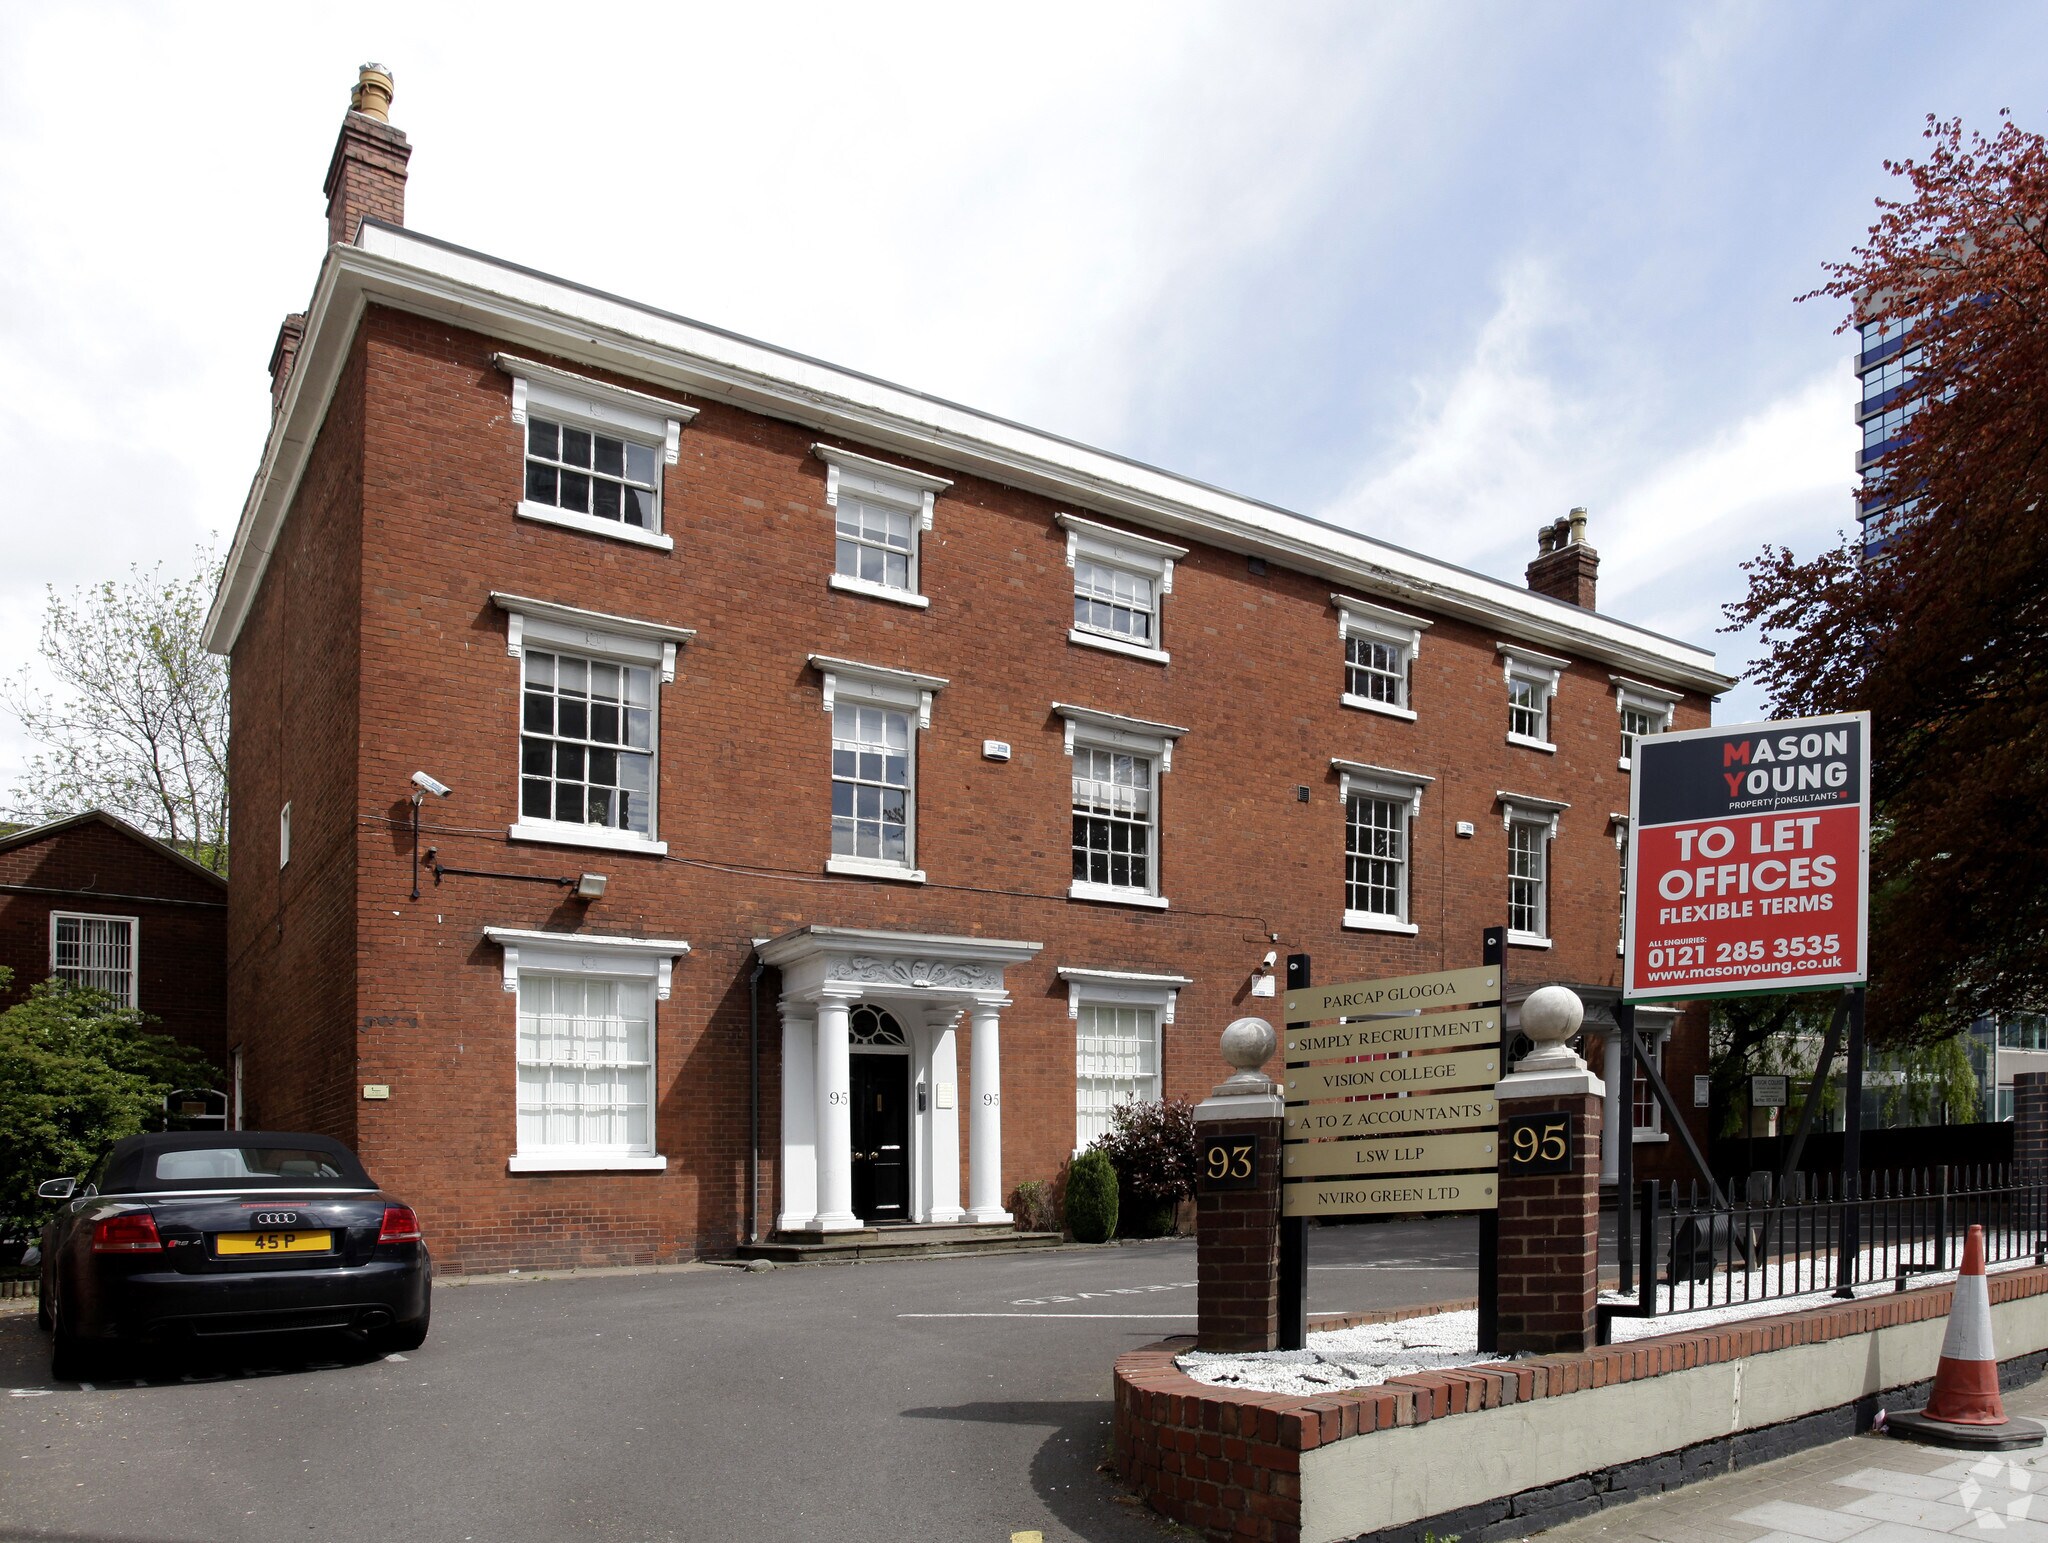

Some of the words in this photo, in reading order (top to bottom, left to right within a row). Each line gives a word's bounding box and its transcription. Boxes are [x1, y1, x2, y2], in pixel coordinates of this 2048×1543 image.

[1723, 730, 1848, 768] MASON
[1723, 761, 1848, 798] YOUNG
[1729, 797, 1773, 810] PROPERTY
[1774, 791, 1838, 805] CONSULTANTS
[1675, 826, 1735, 862] TO
[1750, 816, 1821, 855] LET
[1658, 855, 1837, 901] OFFICES
[1660, 900, 1753, 925] FLEXIBLE
[1759, 893, 1833, 917] TERMS
[1648, 940, 1663, 948] ALL
[1664, 936, 1707, 947] ENQUIRIES:
[1648, 945, 1705, 968] 0121
[1716, 940, 1765, 963] 285
[1773, 934, 1841, 958] 3535
[1648, 955, 1842, 982] www.masonyoung.co.uk
[1323, 991, 1384, 1009] PARCAP
[1388, 982, 1456, 1001] GLOGOA
[1299, 1034, 1353, 1051] SIMPLY
[1359, 1020, 1484, 1045] RECRUITMENT
[1323, 1071, 1375, 1088] VISION
[1380, 1064, 1457, 1083] COLLEGE
[829, 1091, 849, 1106] 95
[983, 1093, 1000, 1107] 95
[1300, 1118, 1311, 1130] A
[1316, 1115, 1337, 1128] TO
[1342, 1114, 1353, 1127] Z
[1357, 1104, 1482, 1126] ACCOUNTANTS
[1356, 1149, 1390, 1164] LSW
[1395, 1147, 1425, 1161] LLP
[1512, 1121, 1567, 1164] 95
[1206, 1145, 1253, 1180] 93
[1318, 1191, 1367, 1205] NVIRO
[1371, 1188, 1424, 1203] GREEN
[1428, 1187, 1460, 1200] LTD
[254, 1234, 279, 1250] 45
[284, 1233, 297, 1249] P
